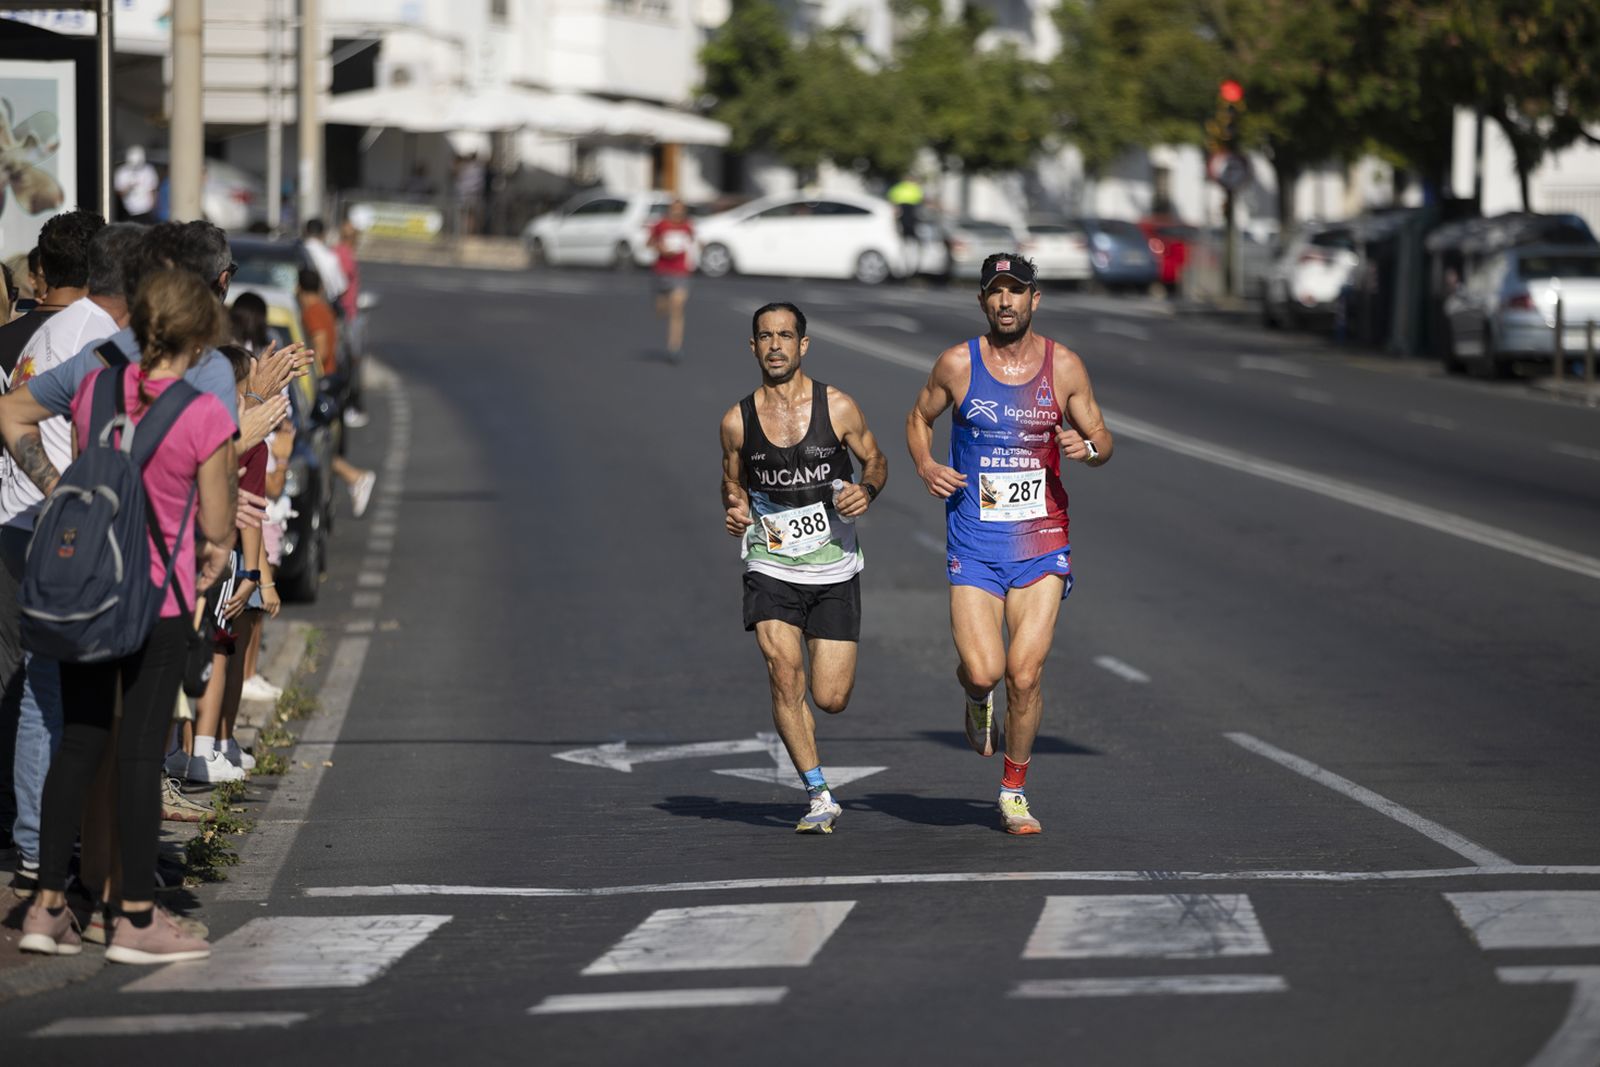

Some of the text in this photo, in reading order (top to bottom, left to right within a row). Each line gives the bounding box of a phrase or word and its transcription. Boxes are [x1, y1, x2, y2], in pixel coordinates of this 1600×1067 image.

[1004, 405, 1058, 421] lapalma
[751, 452, 766, 461] vive
[980, 456, 1041, 468] DELSUR
[1008, 479, 1042, 503] 287
[788, 512, 827, 539] 388
